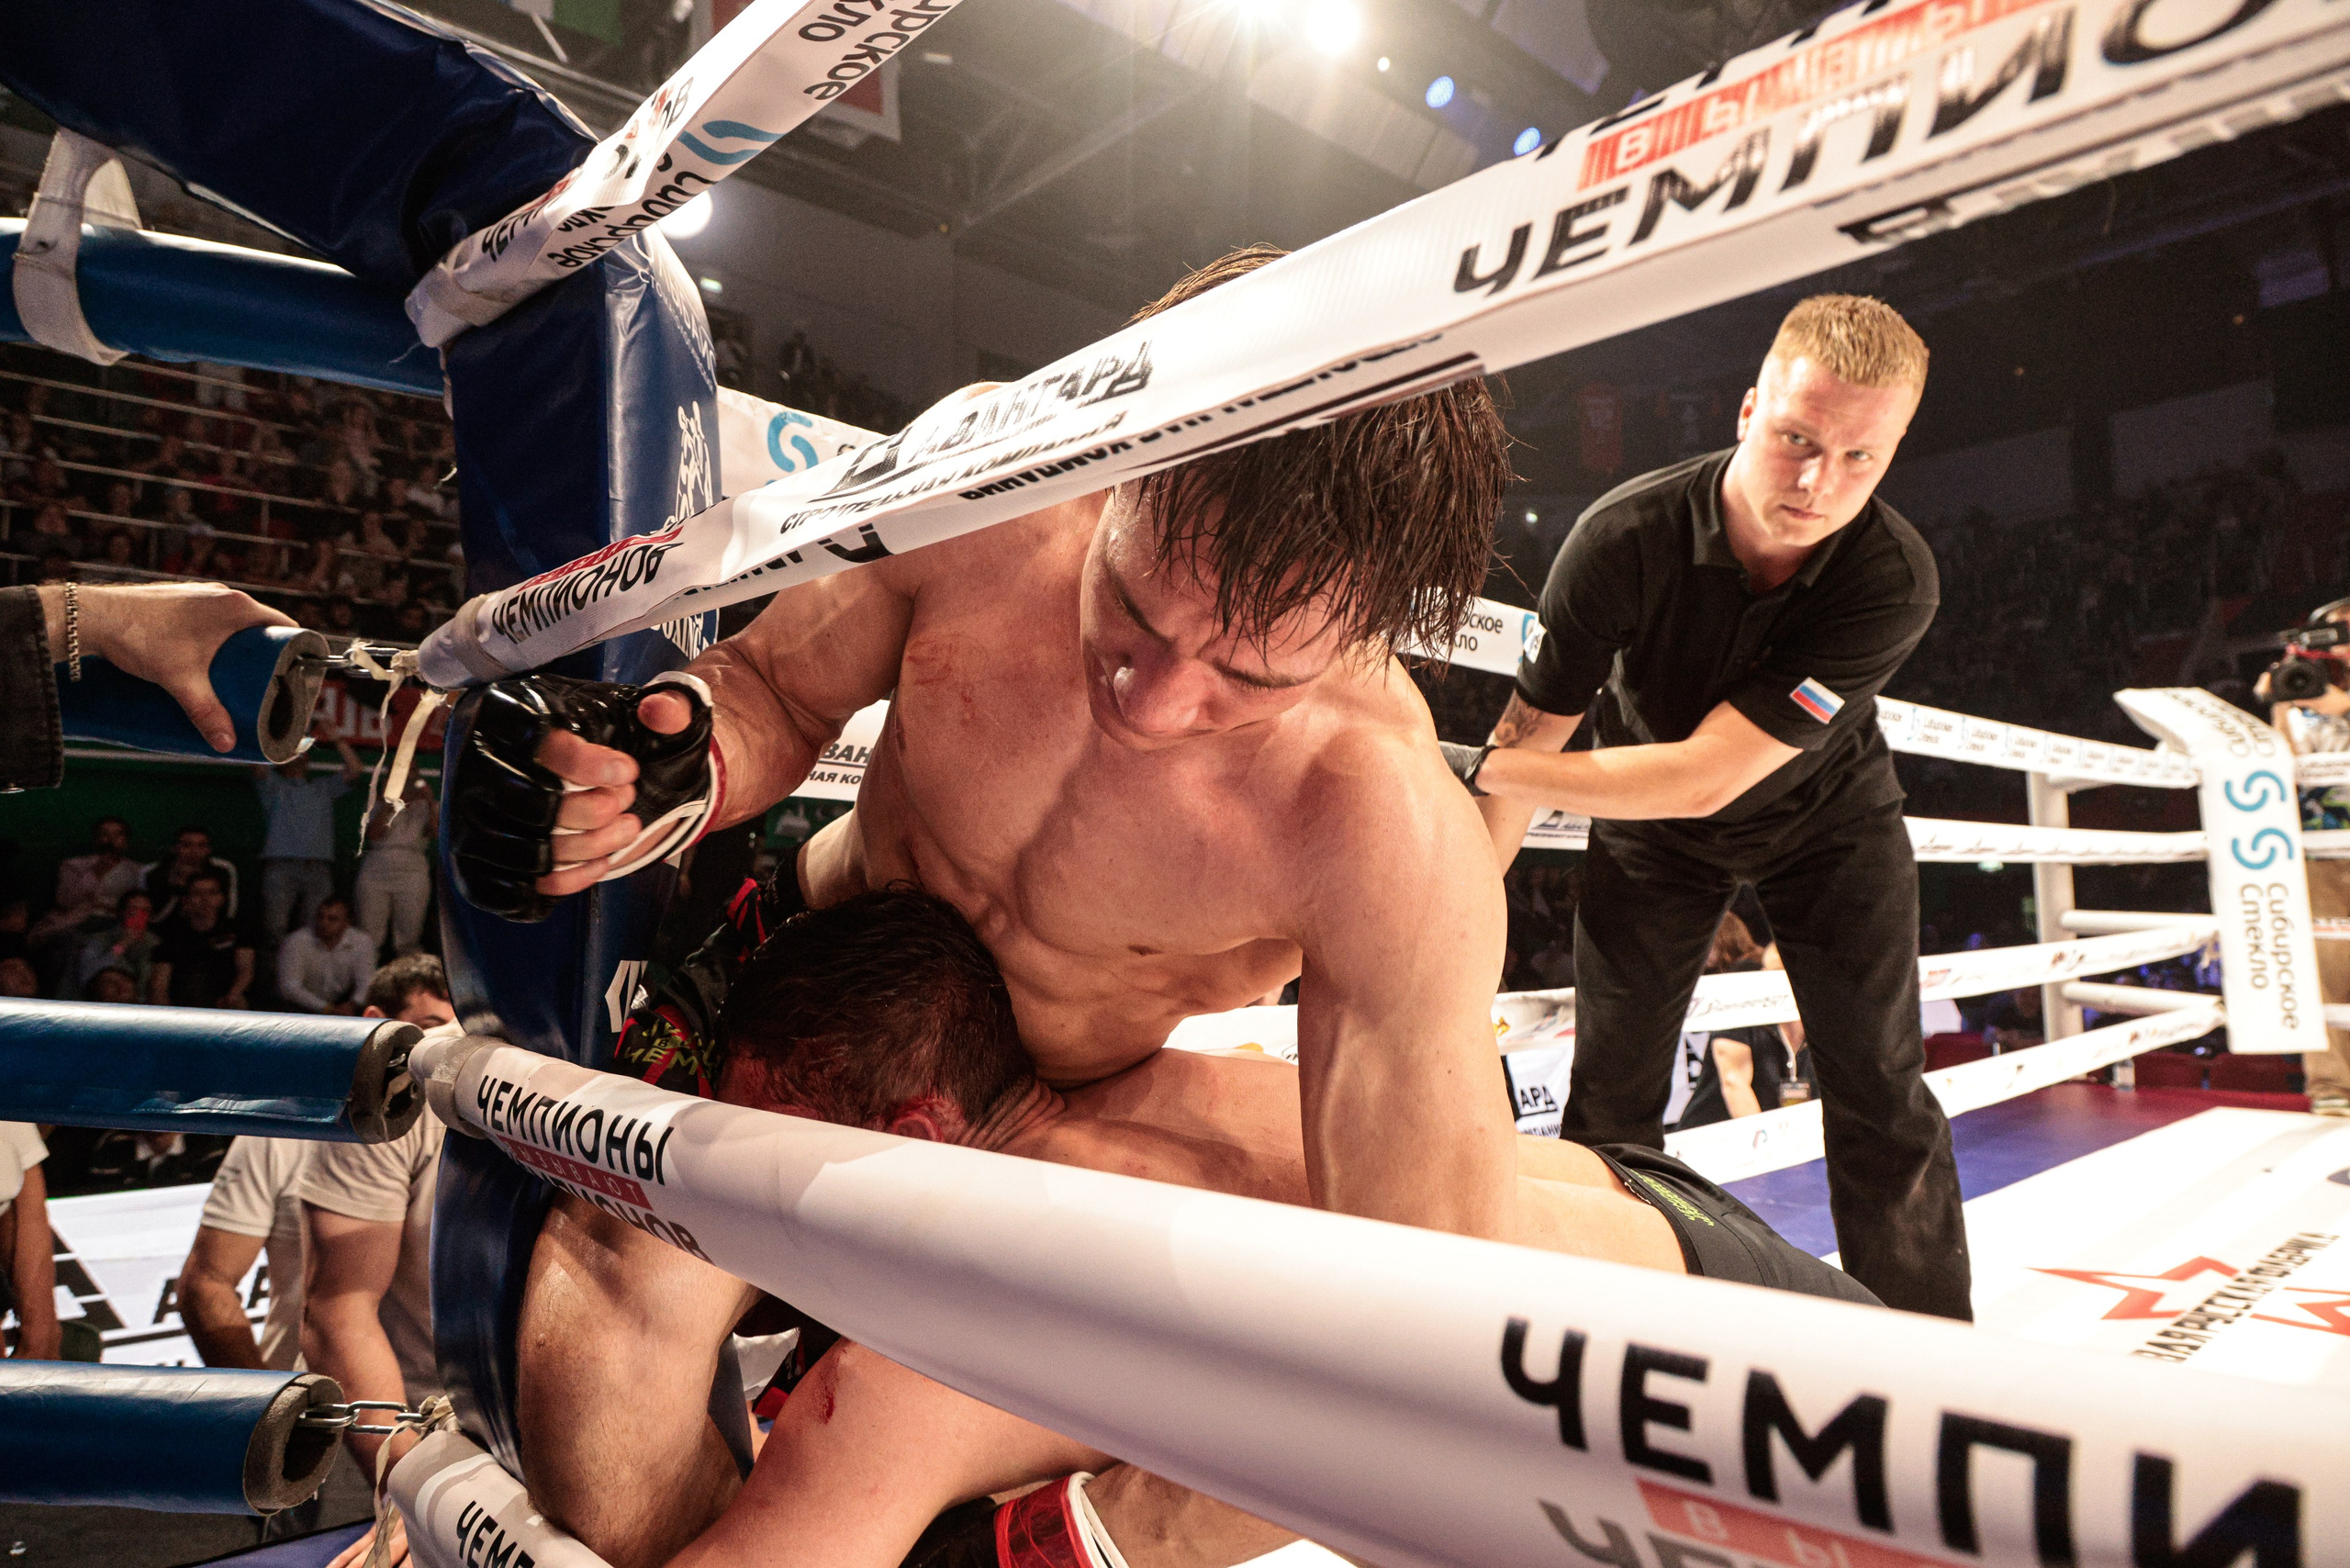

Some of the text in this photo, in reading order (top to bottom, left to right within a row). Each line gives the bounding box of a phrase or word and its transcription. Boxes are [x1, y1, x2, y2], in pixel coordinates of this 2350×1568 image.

[1452, 0, 2286, 299] ЧЕМПИО
[492, 542, 685, 644] ЧЕМПИОНОВ
[840, 774, 862, 785] КО
[2240, 883, 2269, 991] Стекло
[2267, 882, 2300, 1032] Сибирское
[477, 1074, 675, 1186] ЧЕМПИОНЫ
[1499, 1315, 2305, 1568] ЧЕМПИ
